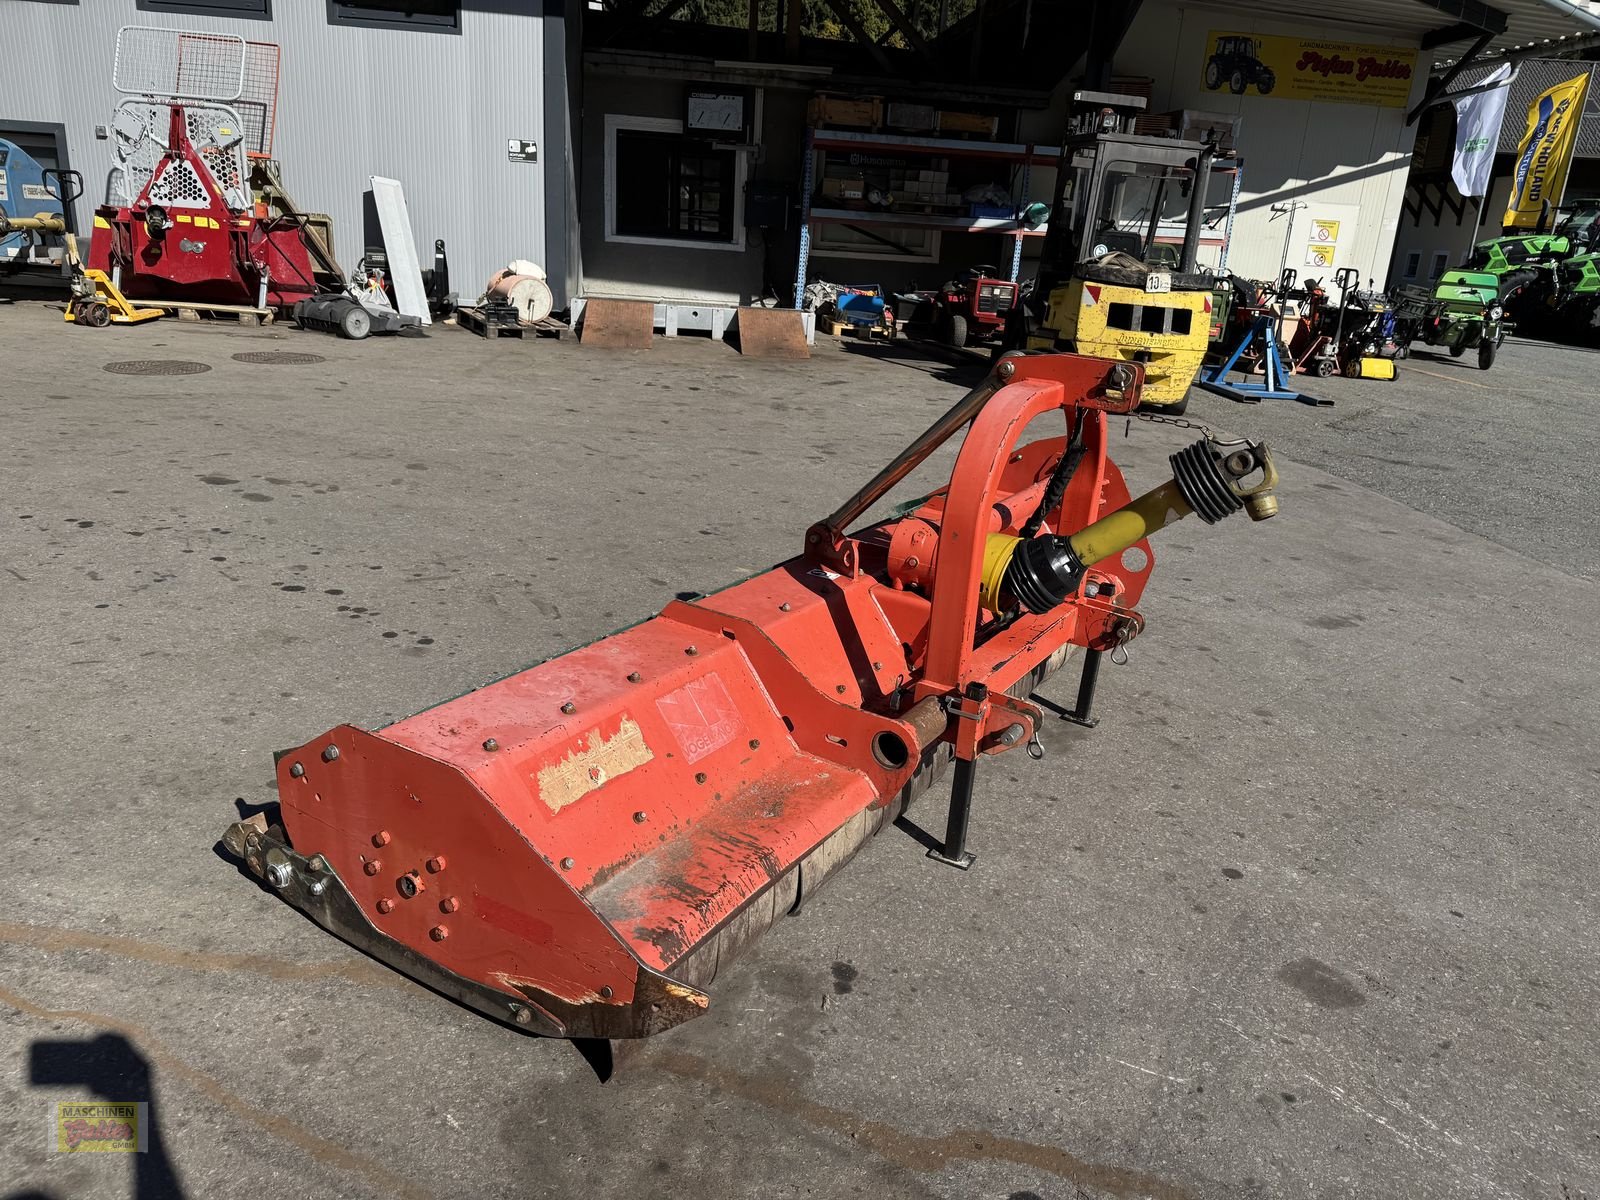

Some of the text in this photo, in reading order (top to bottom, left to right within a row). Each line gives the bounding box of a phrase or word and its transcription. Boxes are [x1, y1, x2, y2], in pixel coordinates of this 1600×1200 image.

[860, 154, 907, 167] Husqvarna
[1529, 146, 1549, 202] HOLLAND
[682, 735, 715, 757] VOGEL
